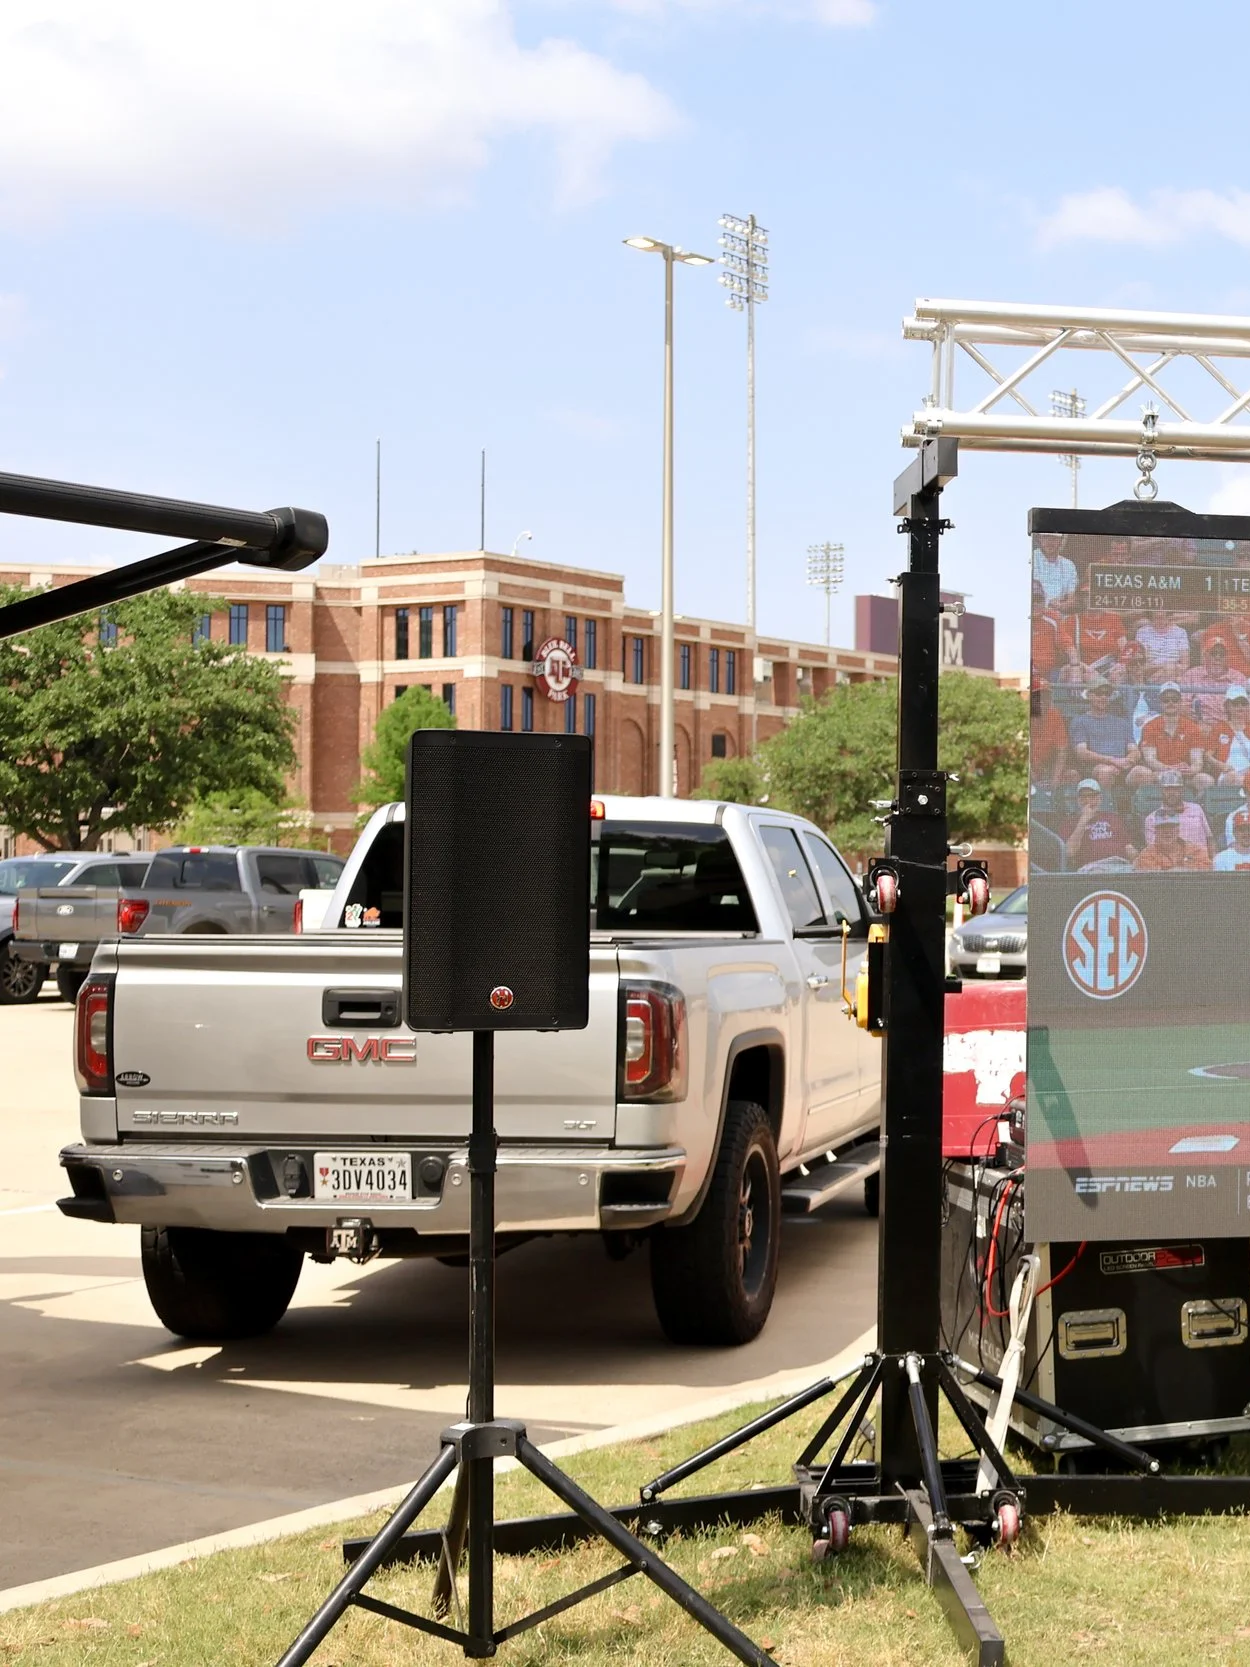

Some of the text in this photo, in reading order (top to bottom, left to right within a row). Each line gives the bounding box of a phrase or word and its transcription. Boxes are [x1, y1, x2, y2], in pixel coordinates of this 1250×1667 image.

[1095, 573, 1212, 591] TEXAS A&M 1
[1095, 595, 1164, 608] 24-17 (8-11)
[1071, 899, 1140, 990] SEC
[307, 1035, 417, 1063] GMC
[133, 1110, 239, 1125] SIERRA
[340, 1157, 385, 1167] TEXAS
[332, 1169, 407, 1191] 3DV4034
[1186, 1175, 1217, 1188] NBA
[1103, 1252, 1156, 1265] OUTDOOR
